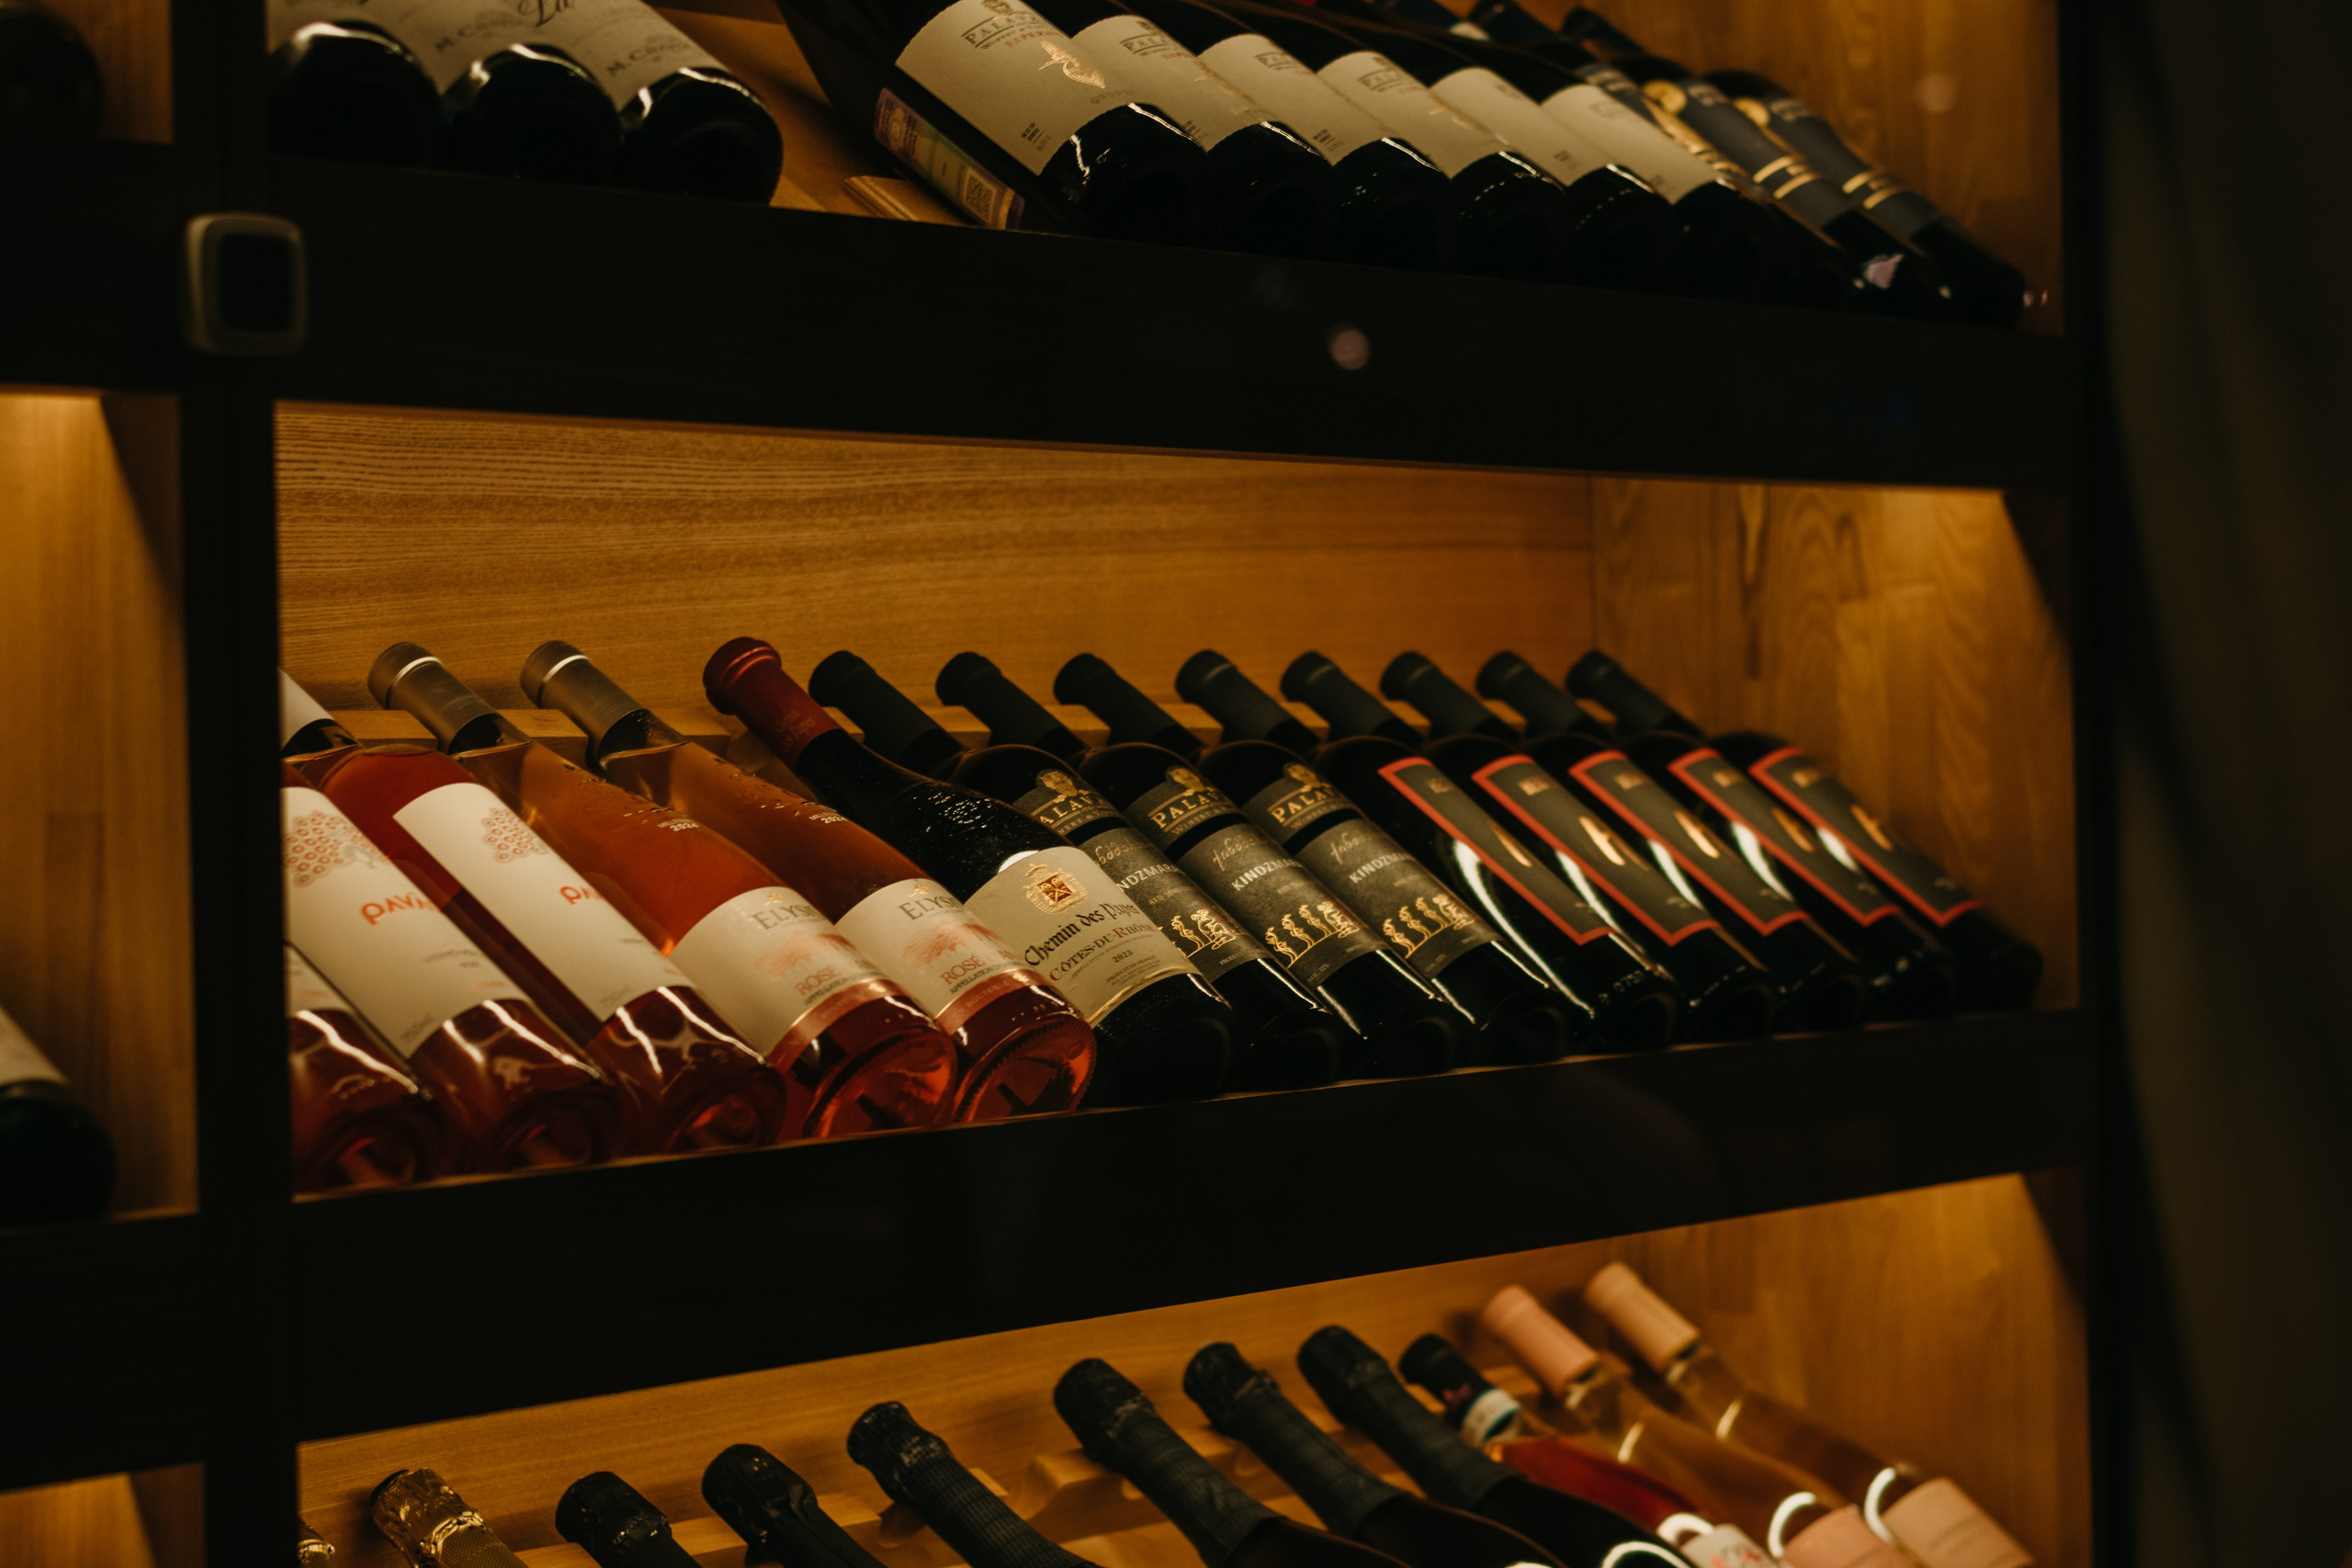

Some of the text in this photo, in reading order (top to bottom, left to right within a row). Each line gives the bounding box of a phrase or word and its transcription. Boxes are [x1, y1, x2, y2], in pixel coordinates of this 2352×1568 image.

[1148, 895, 1164, 906] RED
[1024, 923, 1080, 965] Chemin
[1076, 910, 1105, 927] des
[940, 953, 986, 985] ROSÉ
[1112, 950, 1133, 963] 2023
[950, 966, 994, 994] APPELLATION
[966, 979, 1011, 1008] BOUTEILLE
